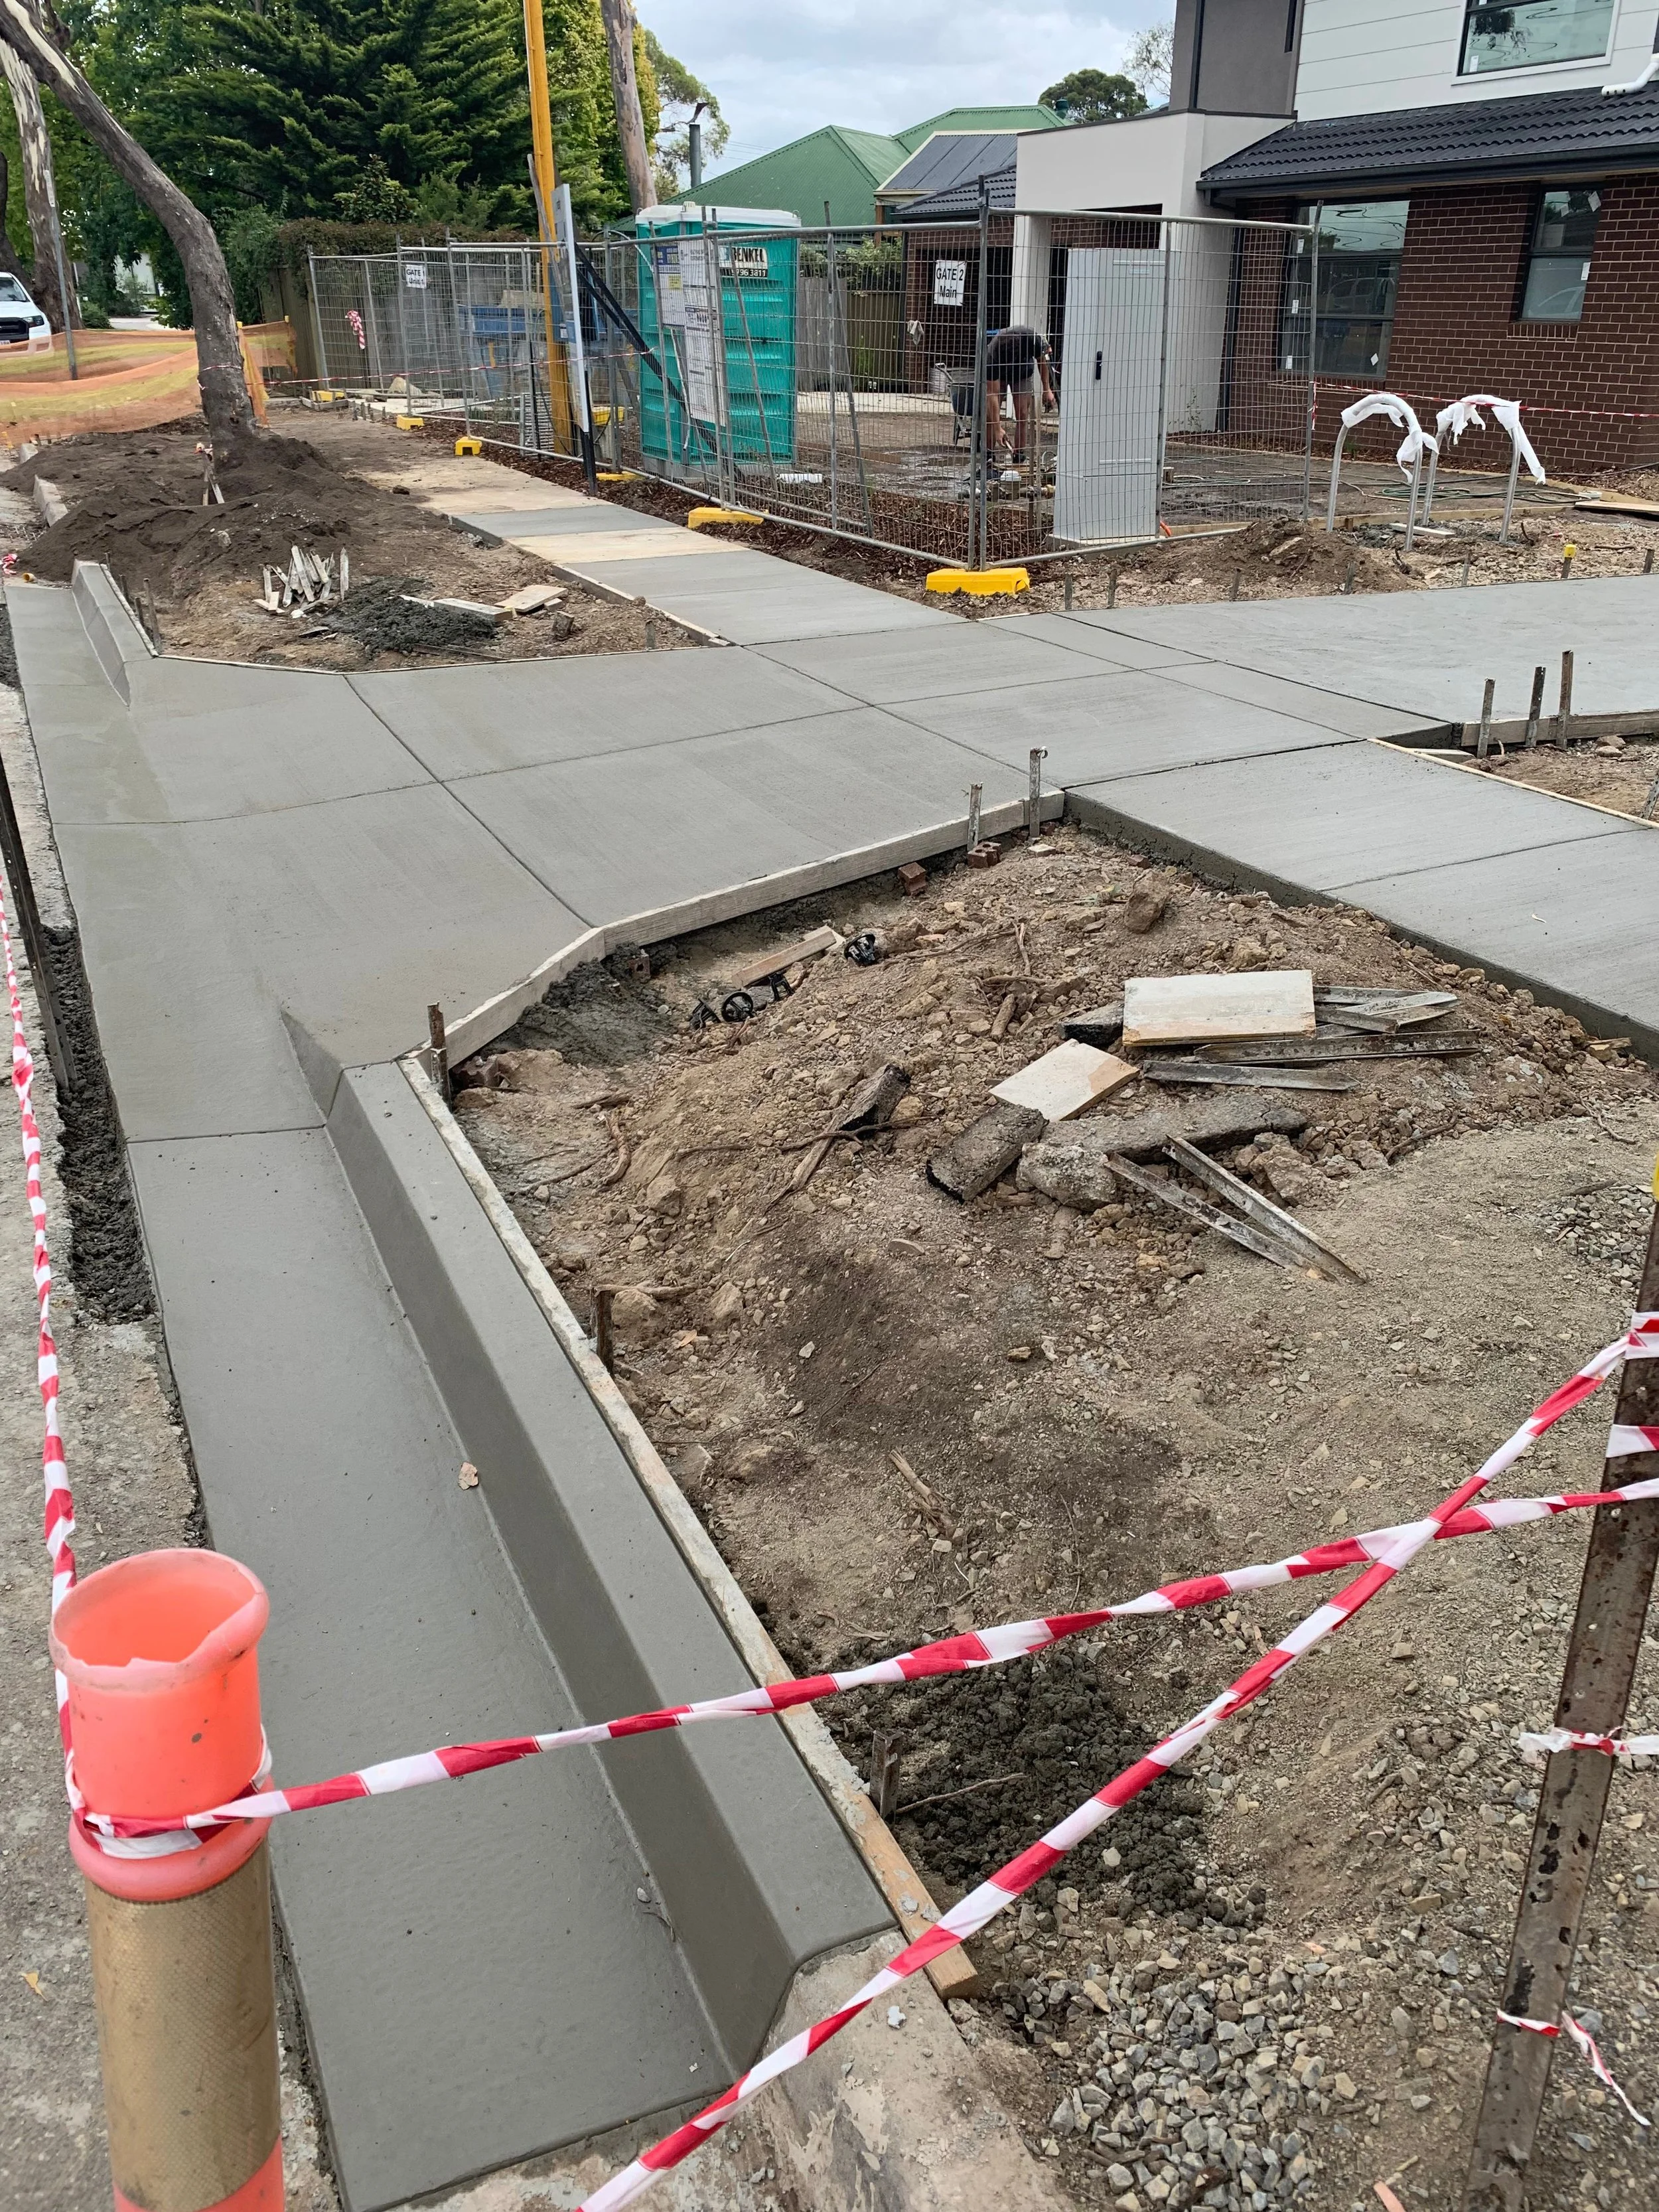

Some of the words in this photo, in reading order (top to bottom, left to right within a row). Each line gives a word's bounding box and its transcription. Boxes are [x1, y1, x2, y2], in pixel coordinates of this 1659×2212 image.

[936, 267, 957, 280] GATE
[958, 269, 964, 281] 2
[939, 285, 957, 299] Main
